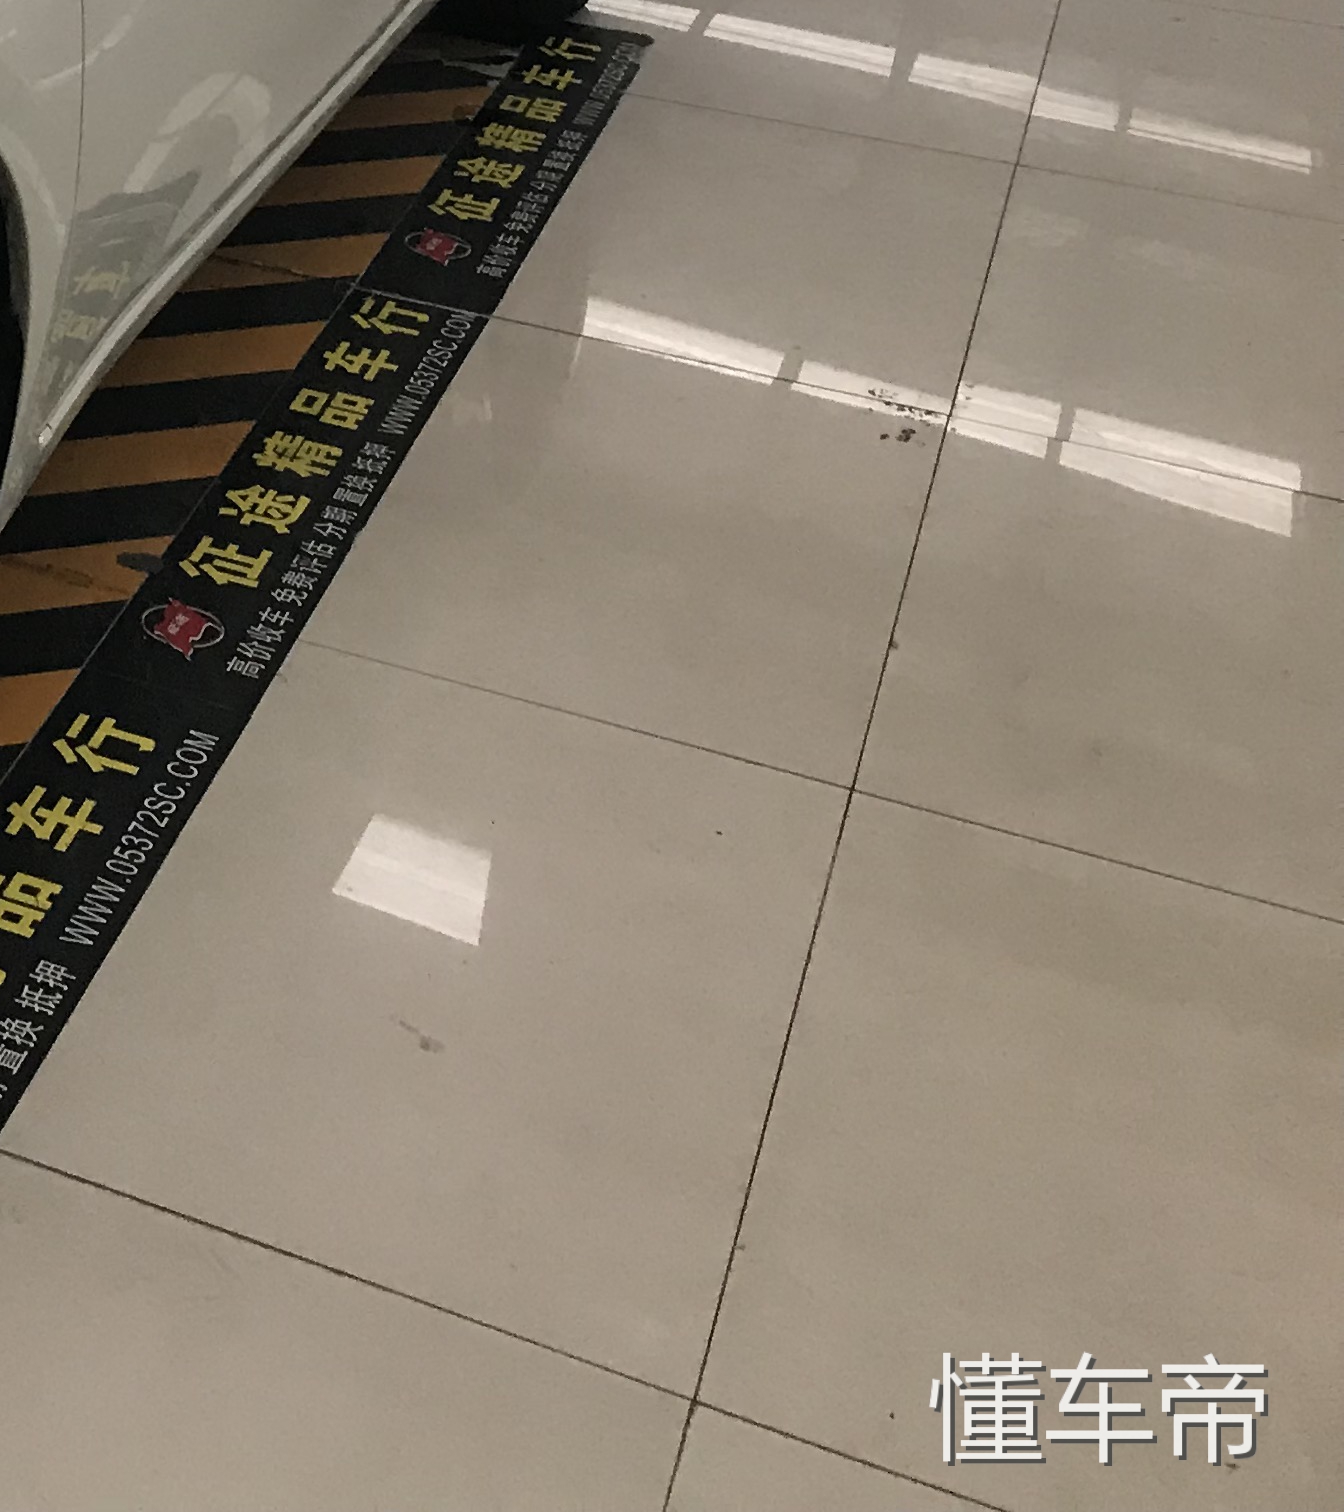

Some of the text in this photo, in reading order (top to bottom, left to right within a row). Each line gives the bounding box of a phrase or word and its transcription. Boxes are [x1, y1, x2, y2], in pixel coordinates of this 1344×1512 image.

[427, 36, 601, 222] 征途精品车行
[179, 299, 430, 588] 征途精品车行
[351, 441, 397, 477] 抵押
[313, 505, 358, 540] 分期
[332, 470, 379, 507] 置换
[271, 538, 337, 606] 免费评估
[226, 607, 295, 679] 高价收车
[14, 960, 76, 1016] 抵押
[59, 730, 219, 946] WWW.05372SC.COM
